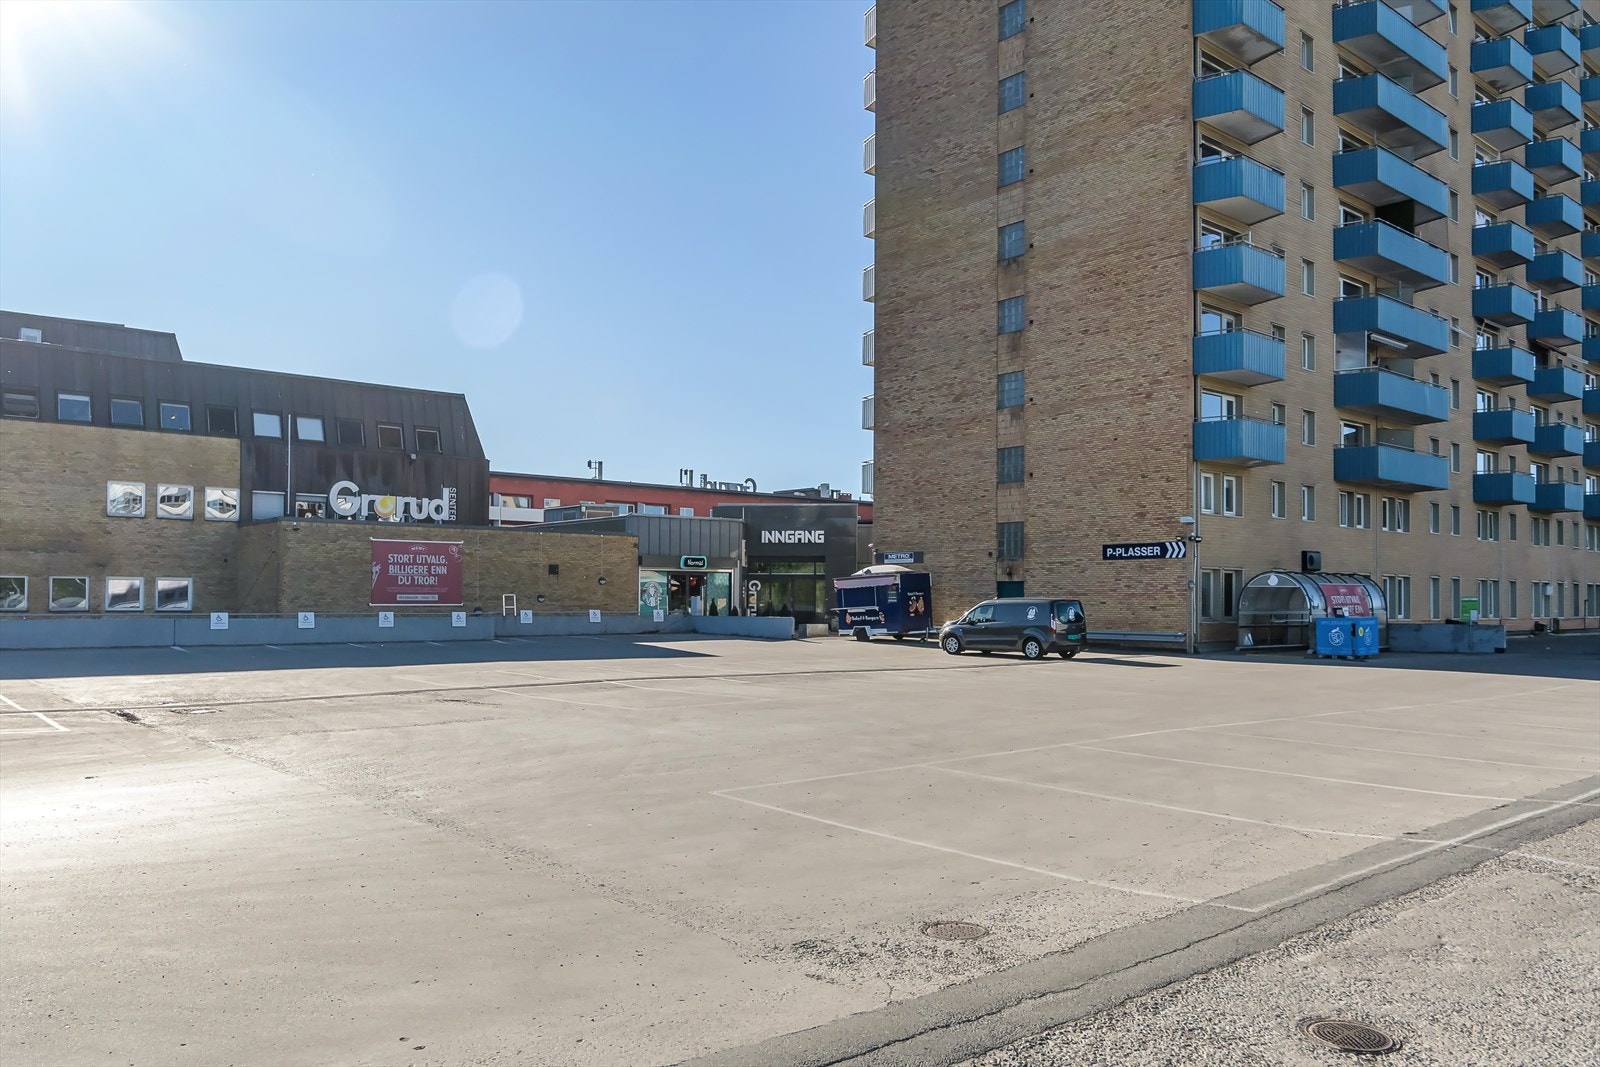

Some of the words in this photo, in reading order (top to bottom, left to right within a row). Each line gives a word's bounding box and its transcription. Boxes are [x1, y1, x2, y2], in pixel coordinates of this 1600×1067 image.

[329, 480, 450, 521] Grorud
[449, 487, 457, 521] SENTER
[761, 530, 825, 544] INNGANG
[1106, 546, 1161, 557] P-PLASSER
[388, 553, 415, 564] STORT
[416, 554, 448, 565] UTVALG.
[687, 558, 704, 566] Normal
[388, 564, 429, 574] BILLIGERE
[431, 565, 448, 575] ENN
[397, 575, 412, 585] DU
[413, 575, 438, 586] TROR!
